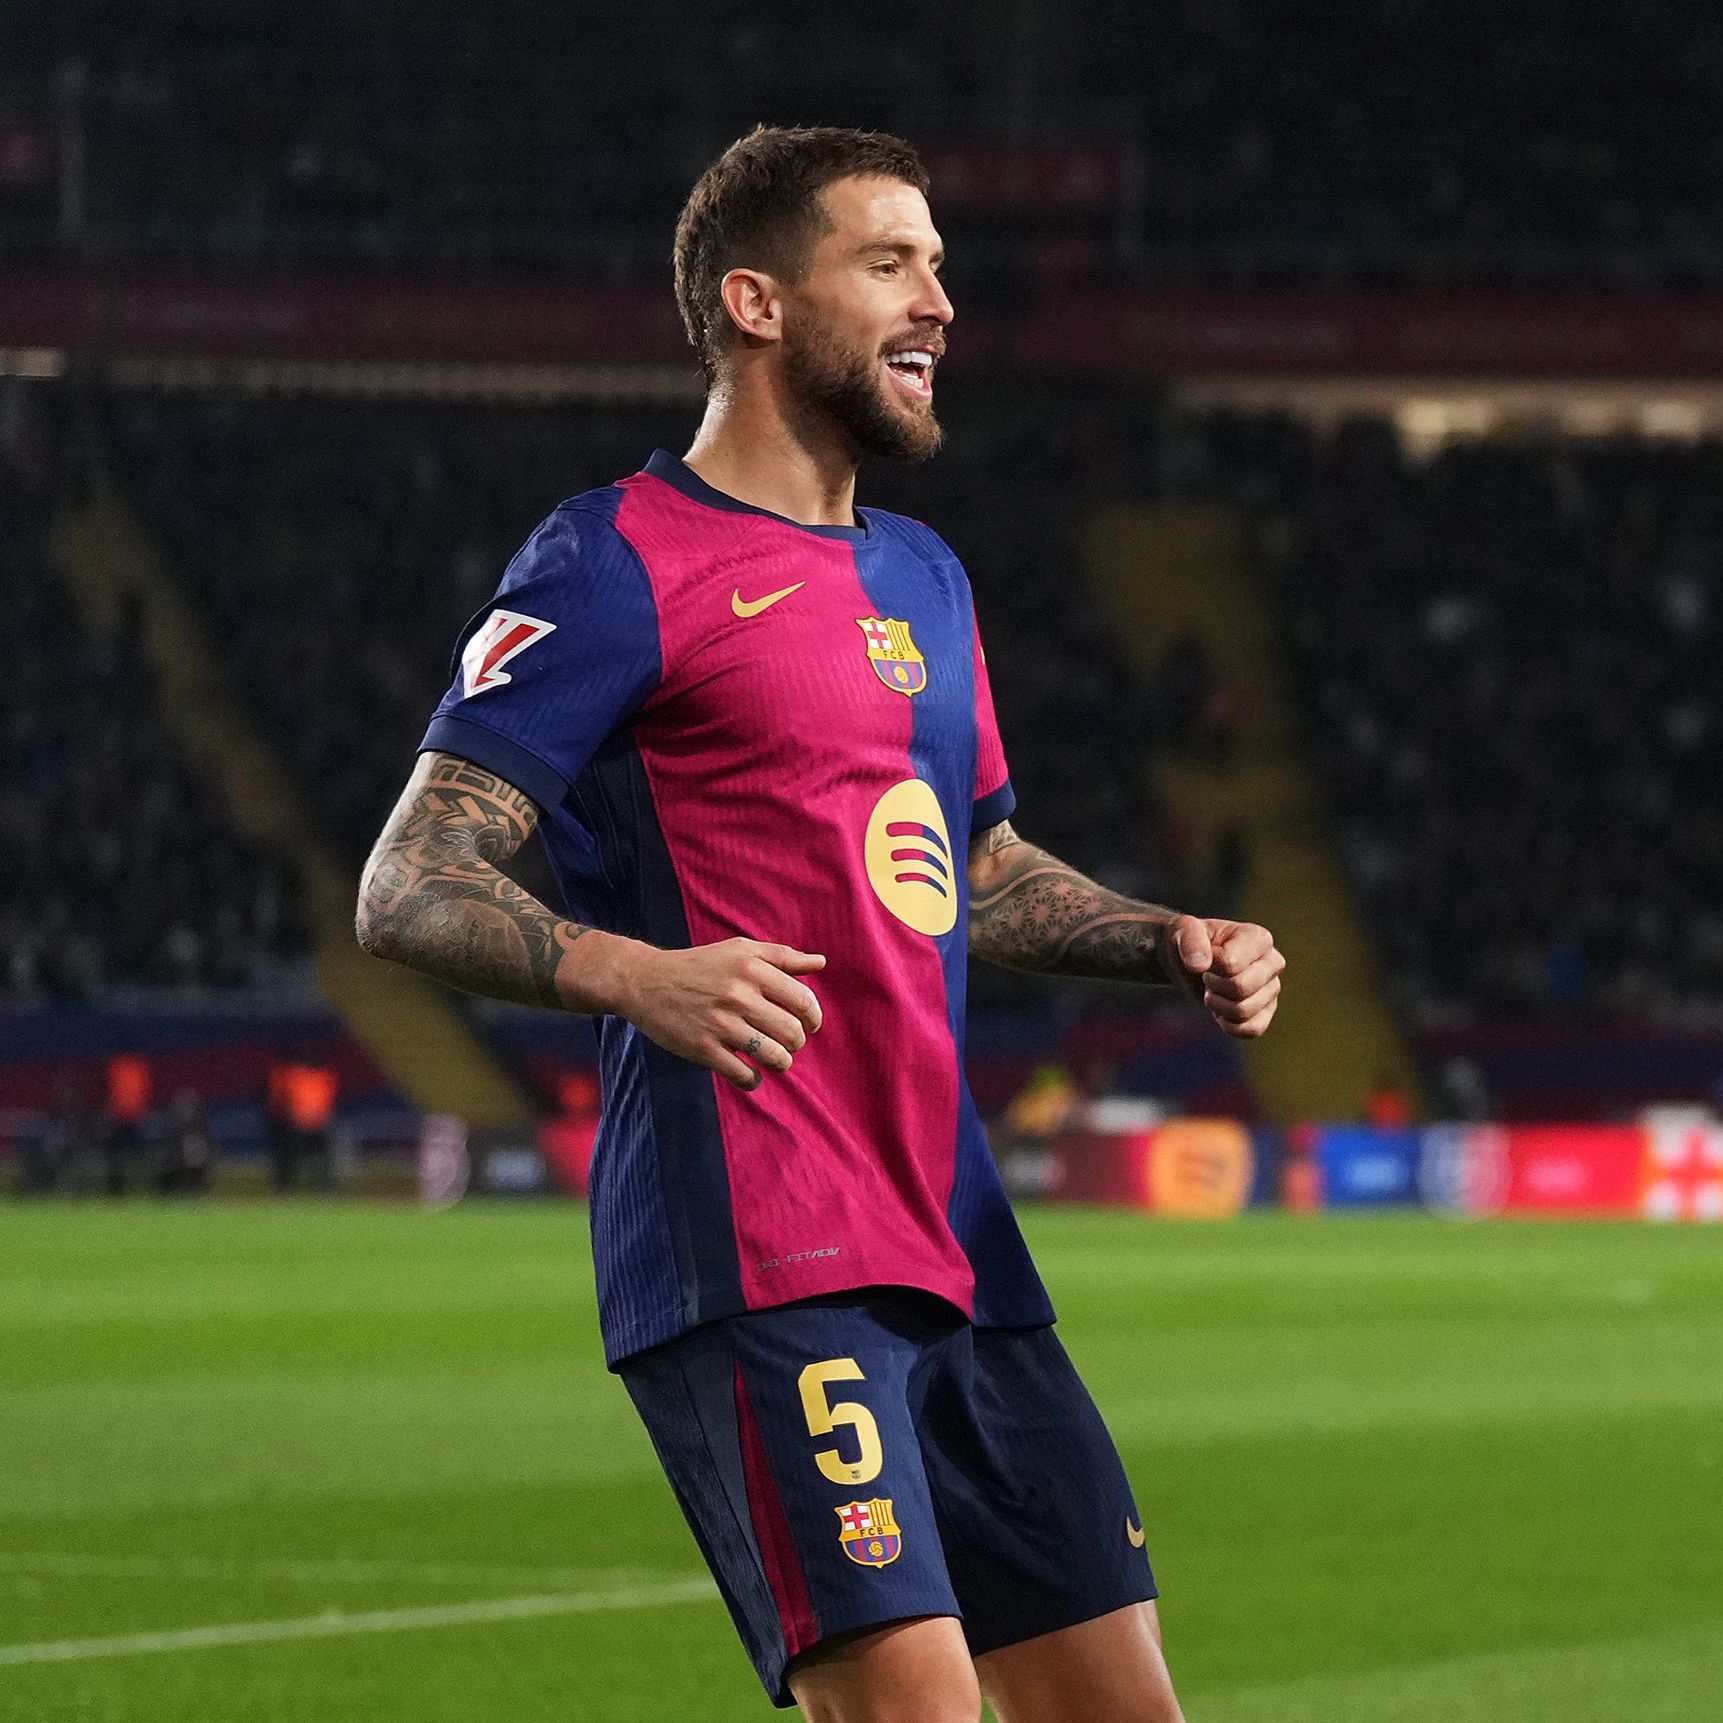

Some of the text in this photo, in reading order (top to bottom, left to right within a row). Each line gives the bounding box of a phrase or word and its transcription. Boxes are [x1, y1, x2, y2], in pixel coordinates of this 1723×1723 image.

[883, 650, 905, 660] FCB
[797, 1358, 884, 1486] 5
[860, 1527, 884, 1537] FCB
